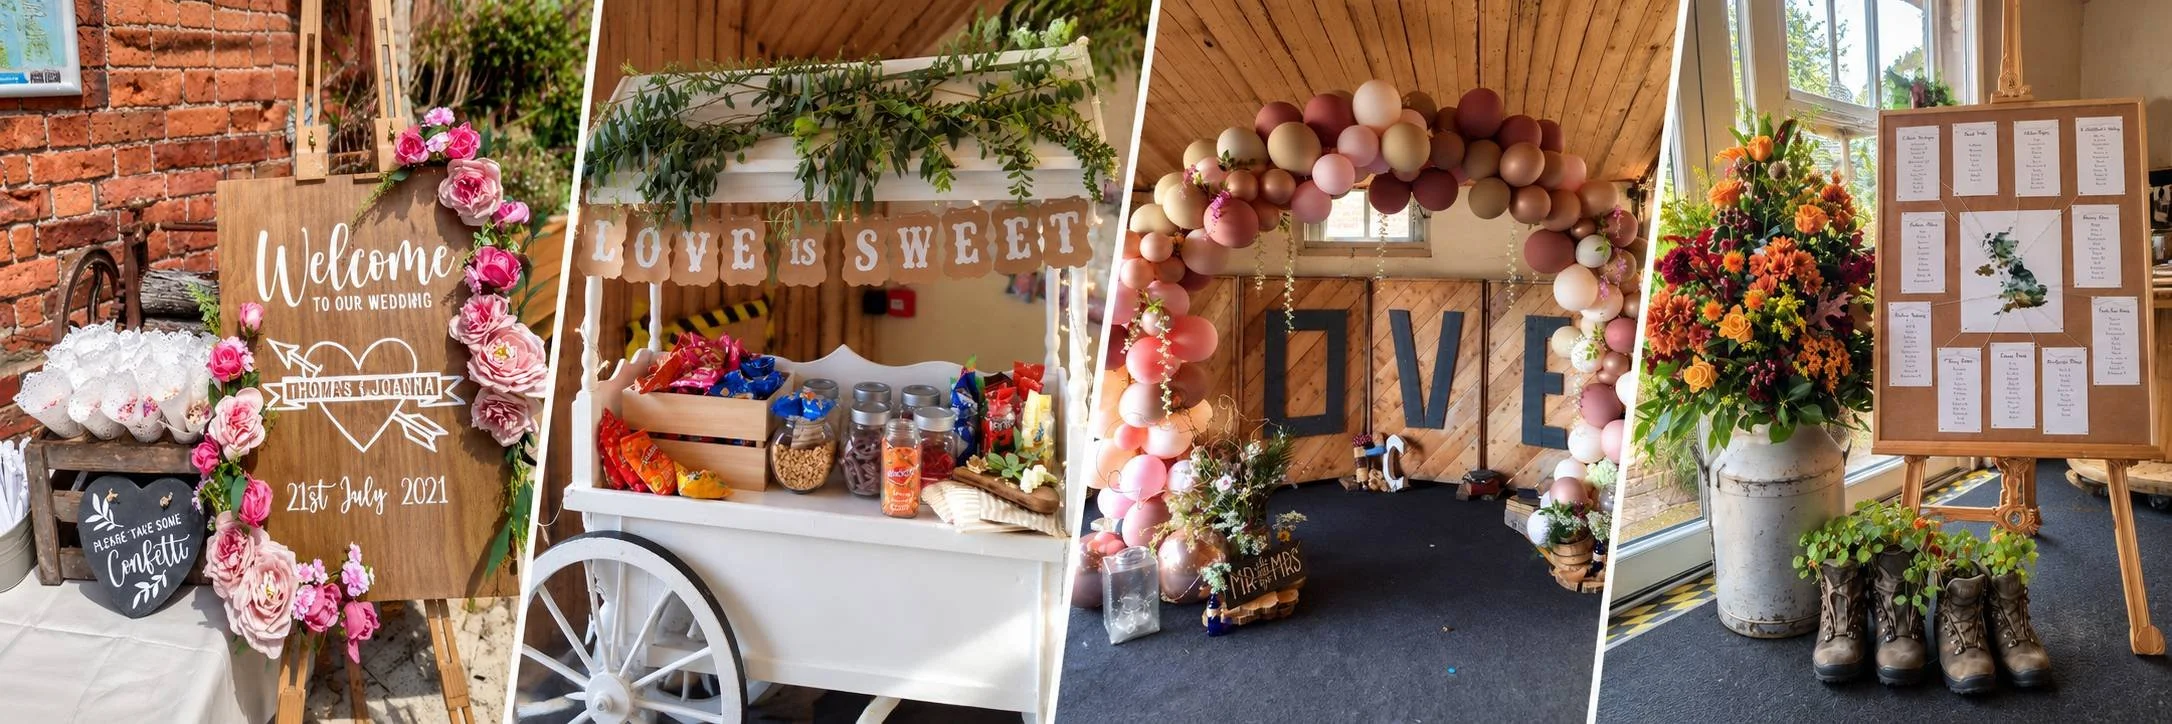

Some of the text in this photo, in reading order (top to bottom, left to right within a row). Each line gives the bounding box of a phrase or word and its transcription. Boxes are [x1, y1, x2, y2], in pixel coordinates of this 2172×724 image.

[256, 222, 455, 308] Welcome
[591, 211, 1080, 273] LOVE IS SWEET
[313, 292, 432, 312] TO OUR WEDDING
[290, 380, 352, 399] THOMAS
[371, 376, 435, 397] JOANNA
[1263, 309, 1571, 451] OVE
[286, 475, 449, 516] 21st July 2021
[93, 512, 182, 553] PLEASE TAKE SOME
[107, 533, 191, 588] Confetti
[1229, 567, 1257, 600] MR
[1270, 546, 1302, 581] MRS
